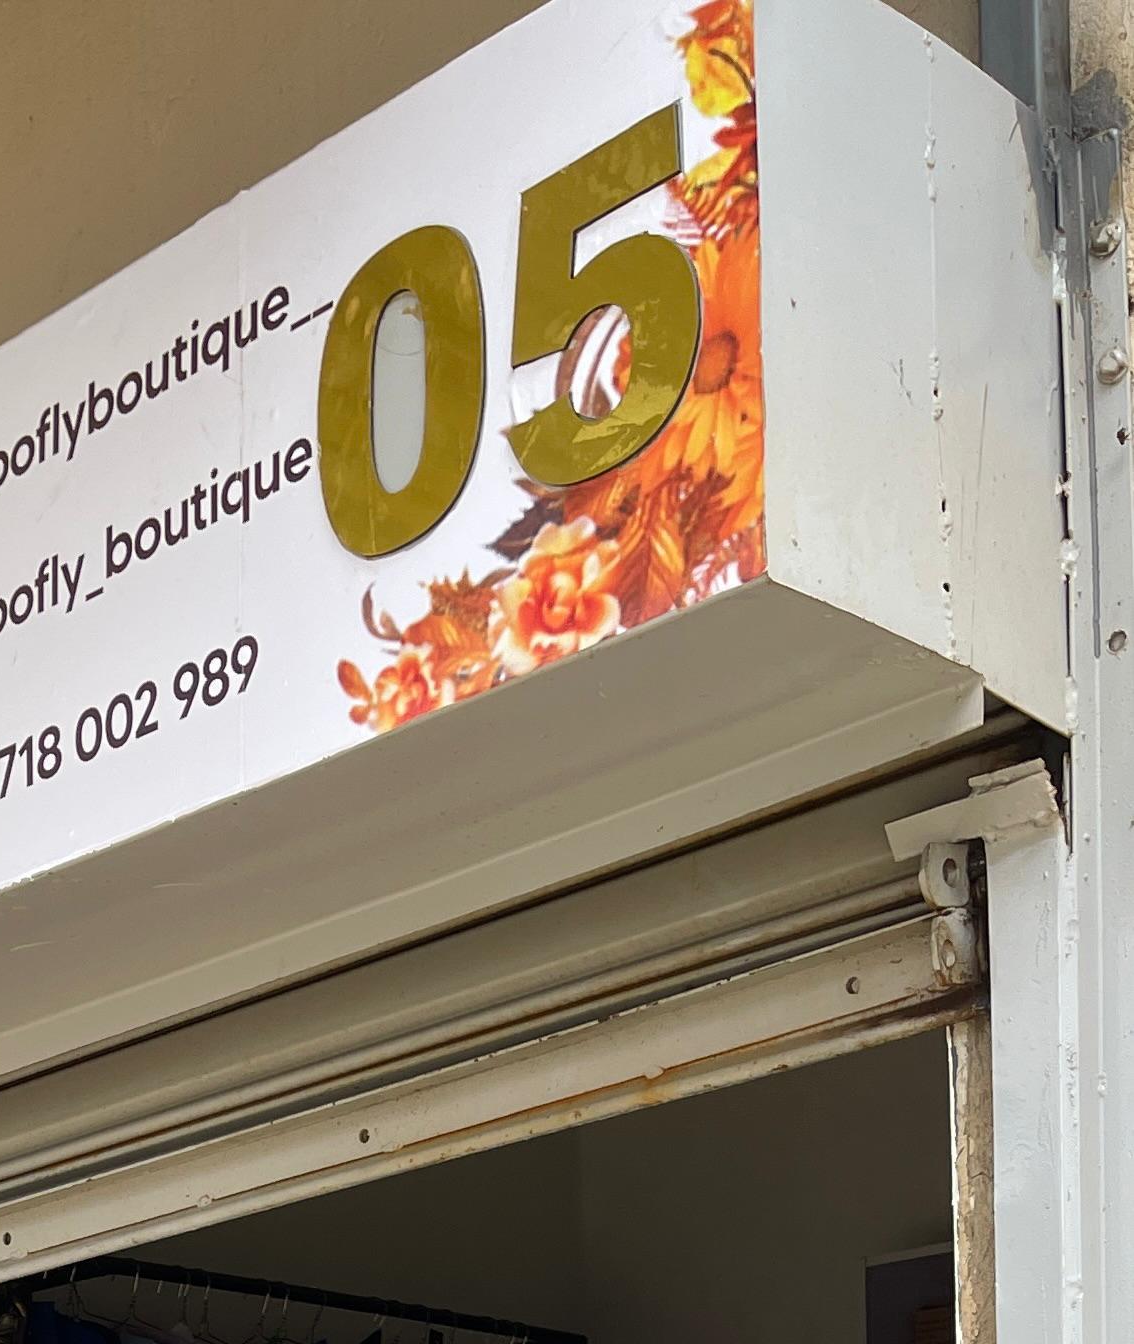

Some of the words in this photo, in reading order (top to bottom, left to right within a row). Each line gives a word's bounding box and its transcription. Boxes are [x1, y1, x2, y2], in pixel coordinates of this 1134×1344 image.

[318, 99, 702, 559] 05
[75, 681, 159, 762] 002
[173, 636, 259, 720] 989
